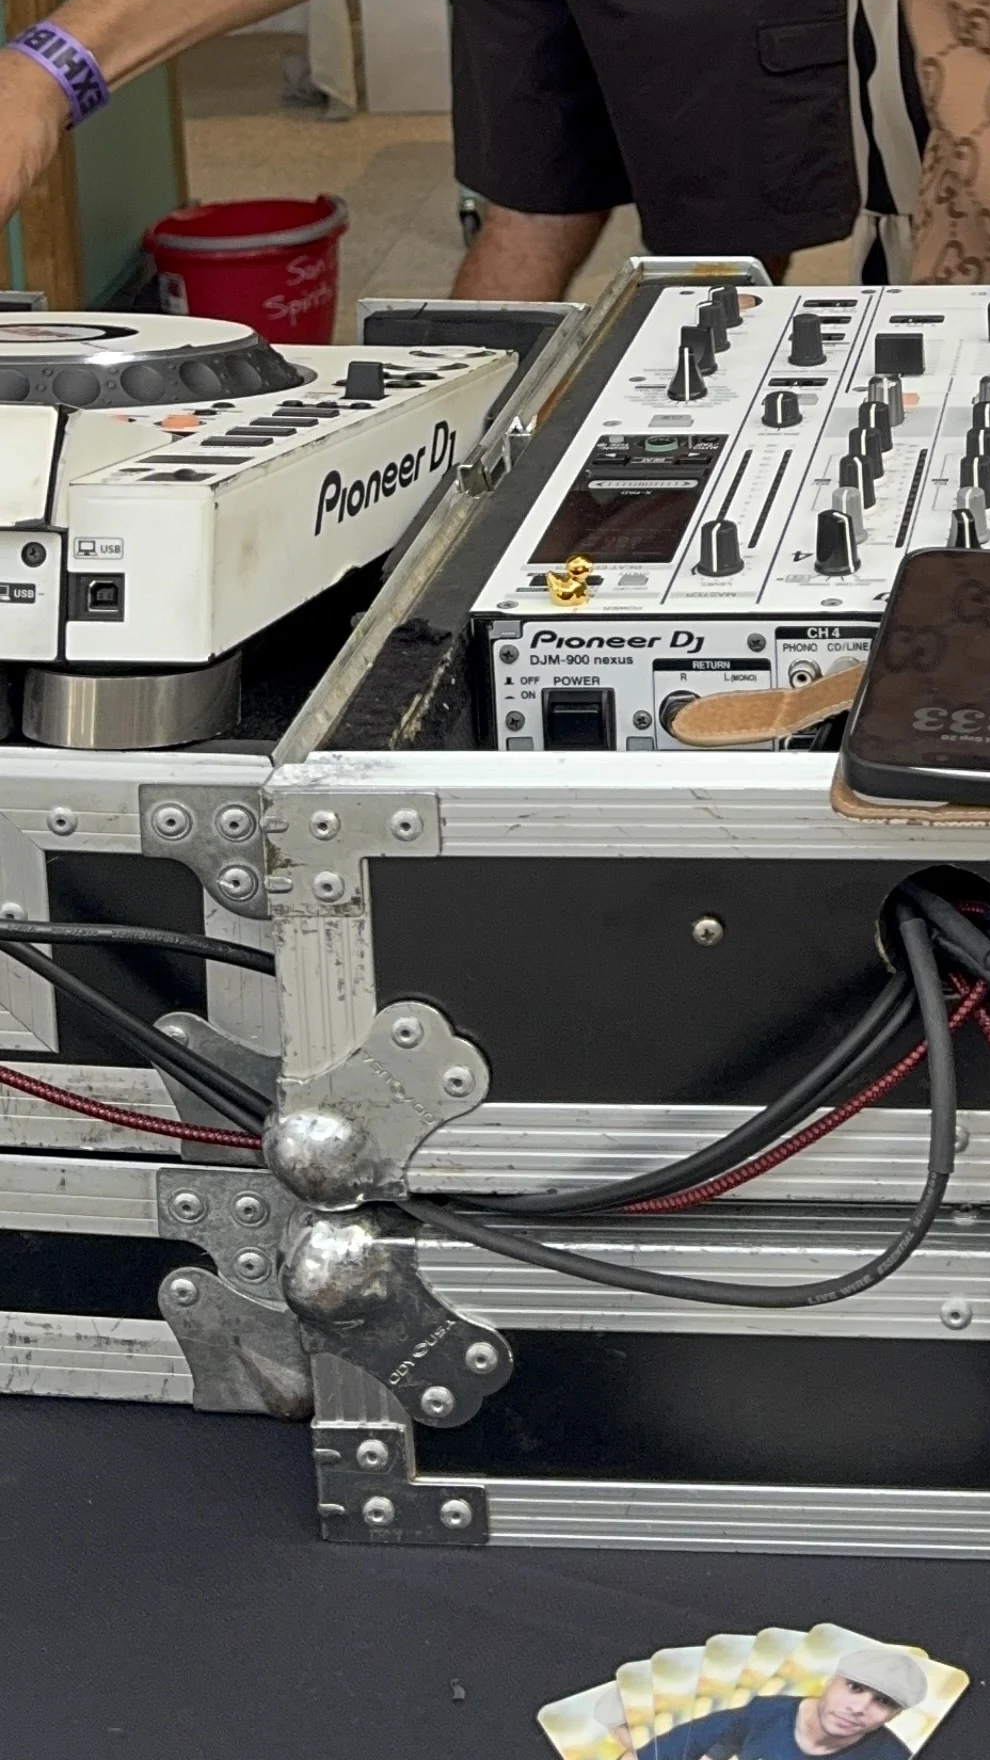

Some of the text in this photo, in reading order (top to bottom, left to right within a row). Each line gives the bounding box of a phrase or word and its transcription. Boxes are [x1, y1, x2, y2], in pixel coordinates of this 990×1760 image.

[314, 444, 426, 536] Pioneer
[100, 543, 122, 555] USB
[791, 551, 814, 563] 4
[13, 589, 35, 598] USB
[807, 627, 841, 639] CH 4
[530, 631, 662, 649] Pioneer
[783, 642, 870, 652] PHONO CD/LINE
[530, 654, 634, 666] DJM-900 nexus
[692, 660, 731, 670] RETURN
[520, 676, 601, 686] OFF POWER
[680, 673, 688, 682] R
[521, 691, 537, 700] ON
[807, 1291, 838, 1304] LIVE
[840, 1274, 873, 1296] WIRE
